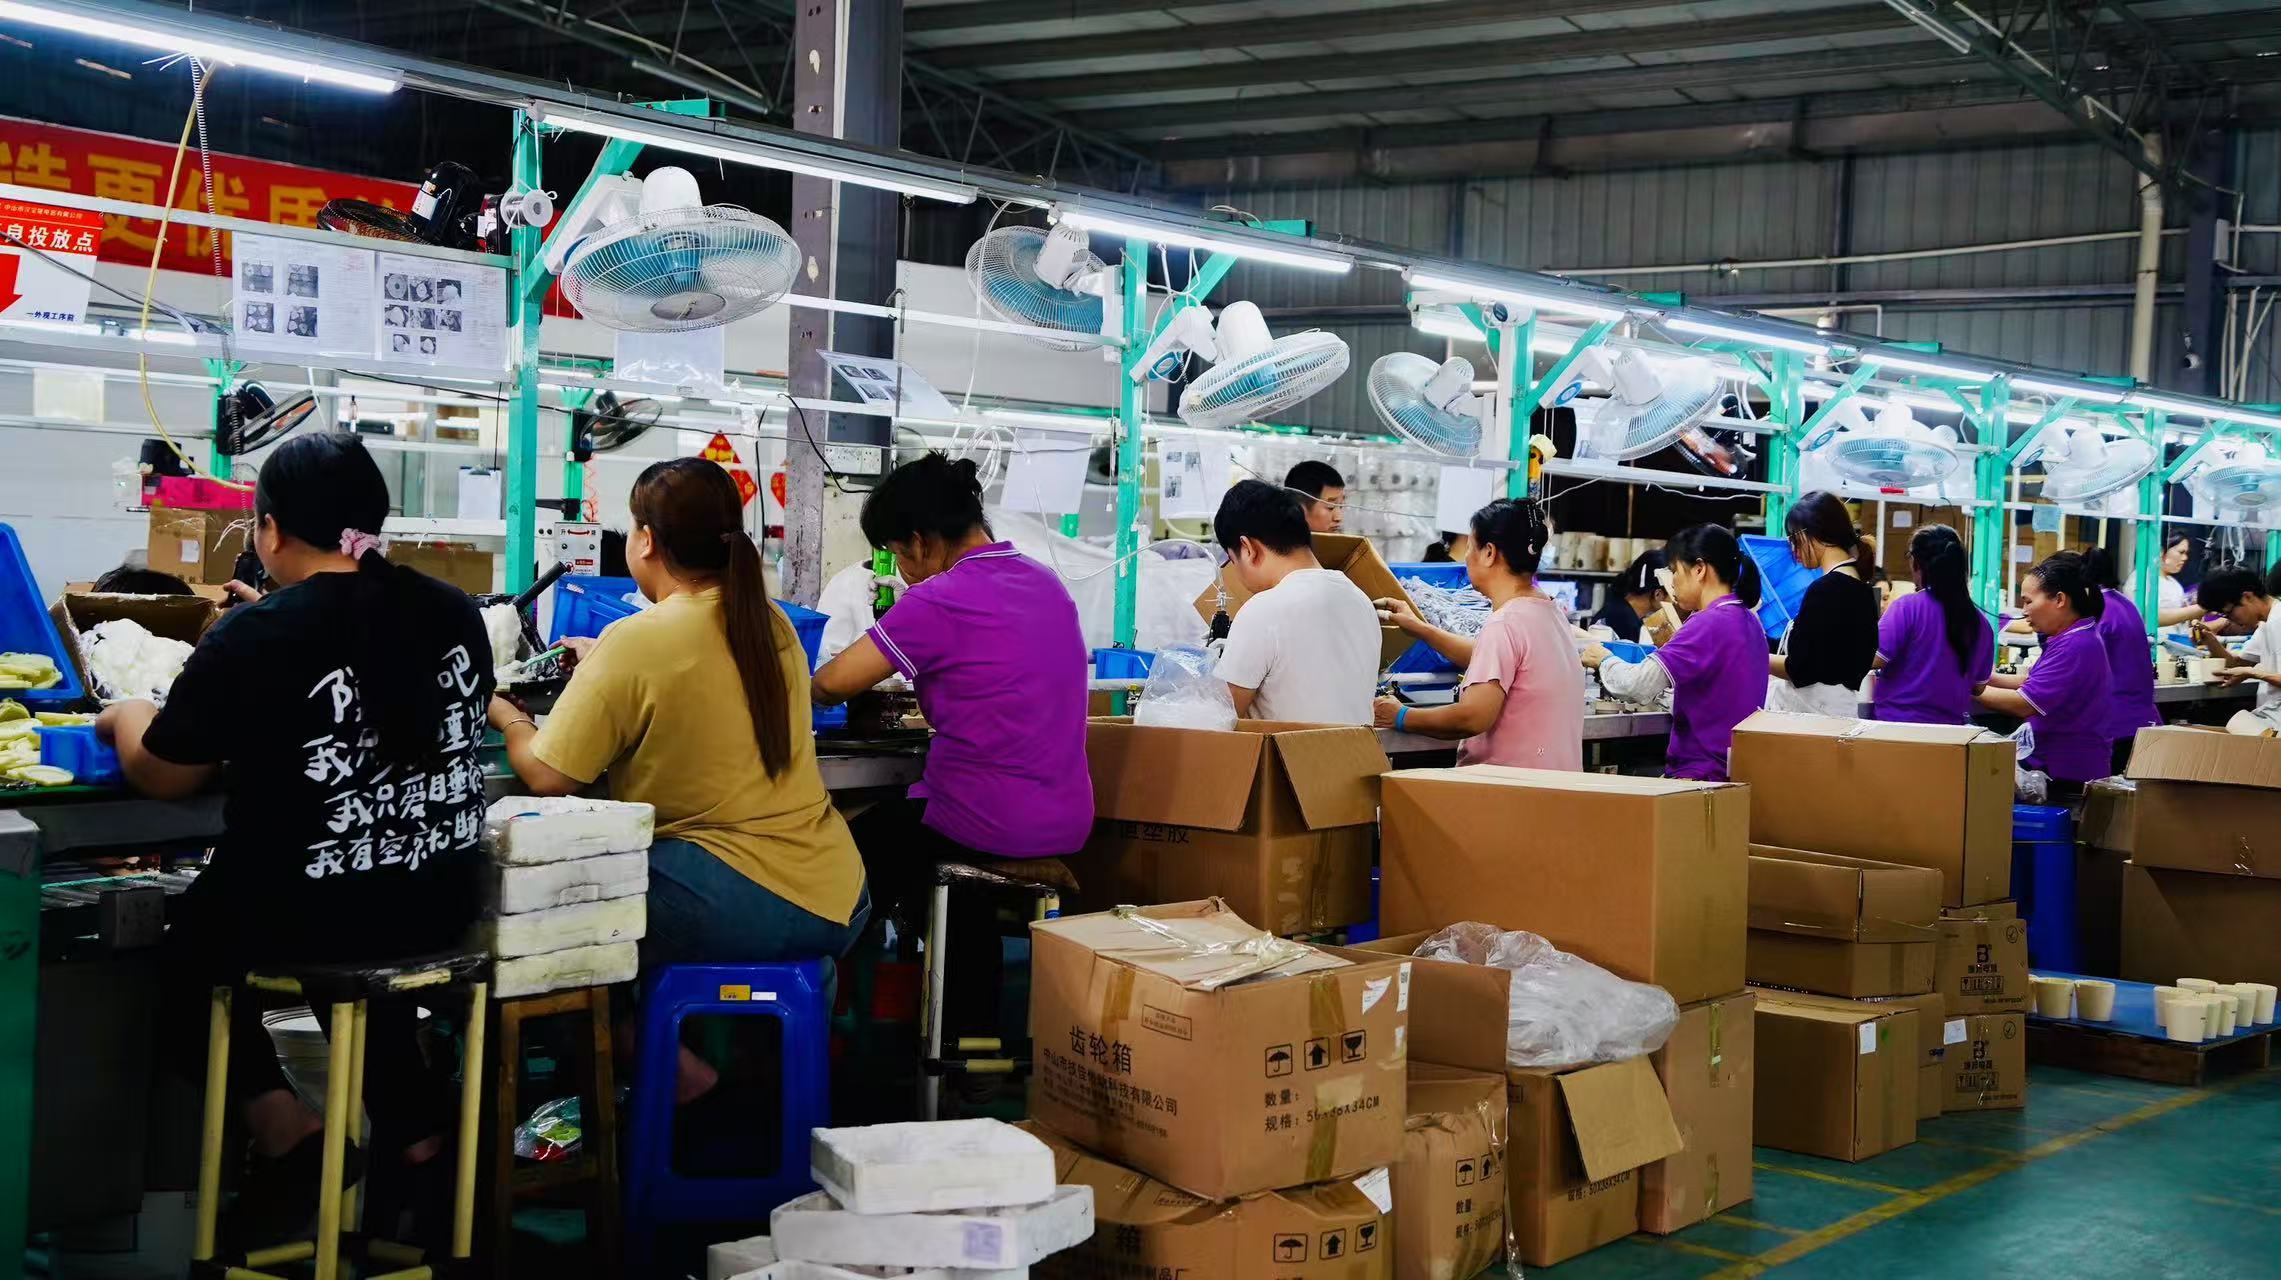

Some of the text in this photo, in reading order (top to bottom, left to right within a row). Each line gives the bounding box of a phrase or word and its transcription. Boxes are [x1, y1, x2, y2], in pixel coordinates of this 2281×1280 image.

[0, 222, 95, 253] 良投放点
[1069, 1024, 1132, 1075] 齿轮箱
